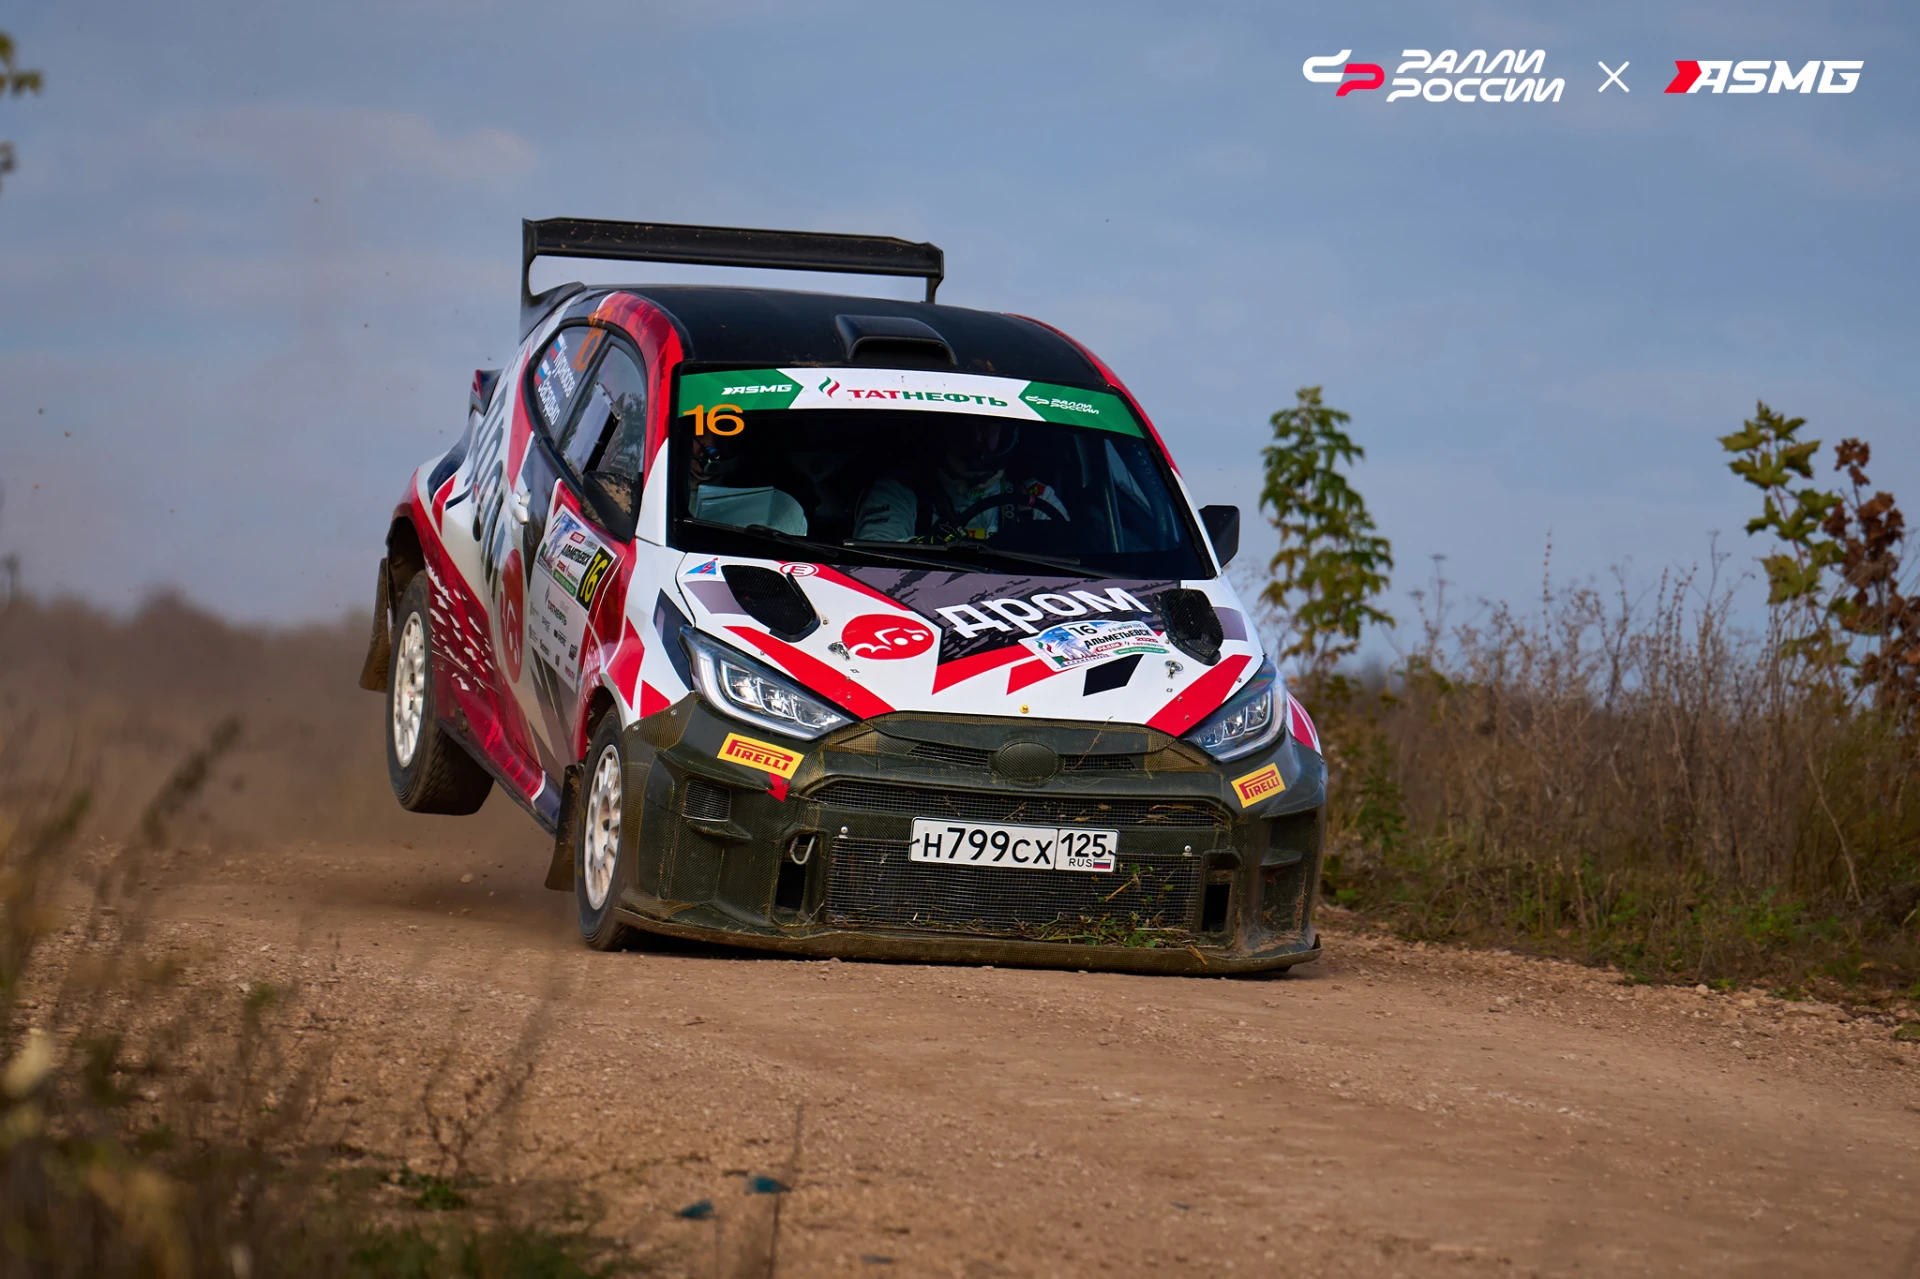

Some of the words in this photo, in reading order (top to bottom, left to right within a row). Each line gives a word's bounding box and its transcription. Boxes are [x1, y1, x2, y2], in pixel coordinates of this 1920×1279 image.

[731, 384, 792, 395] ASMG
[846, 389, 1008, 407] ТАТНЕФТЬ
[683, 403, 745, 436] 16
[580, 553, 608, 603] 16
[1068, 625, 1098, 636] 16
[1083, 629, 1153, 650] АЛЬМЕТЬЕВСК
[725, 739, 794, 772] PIRELLI
[1238, 769, 1281, 800] PIRELLI
[1060, 832, 1108, 857] 125
[1068, 857, 1093, 868] RUS
